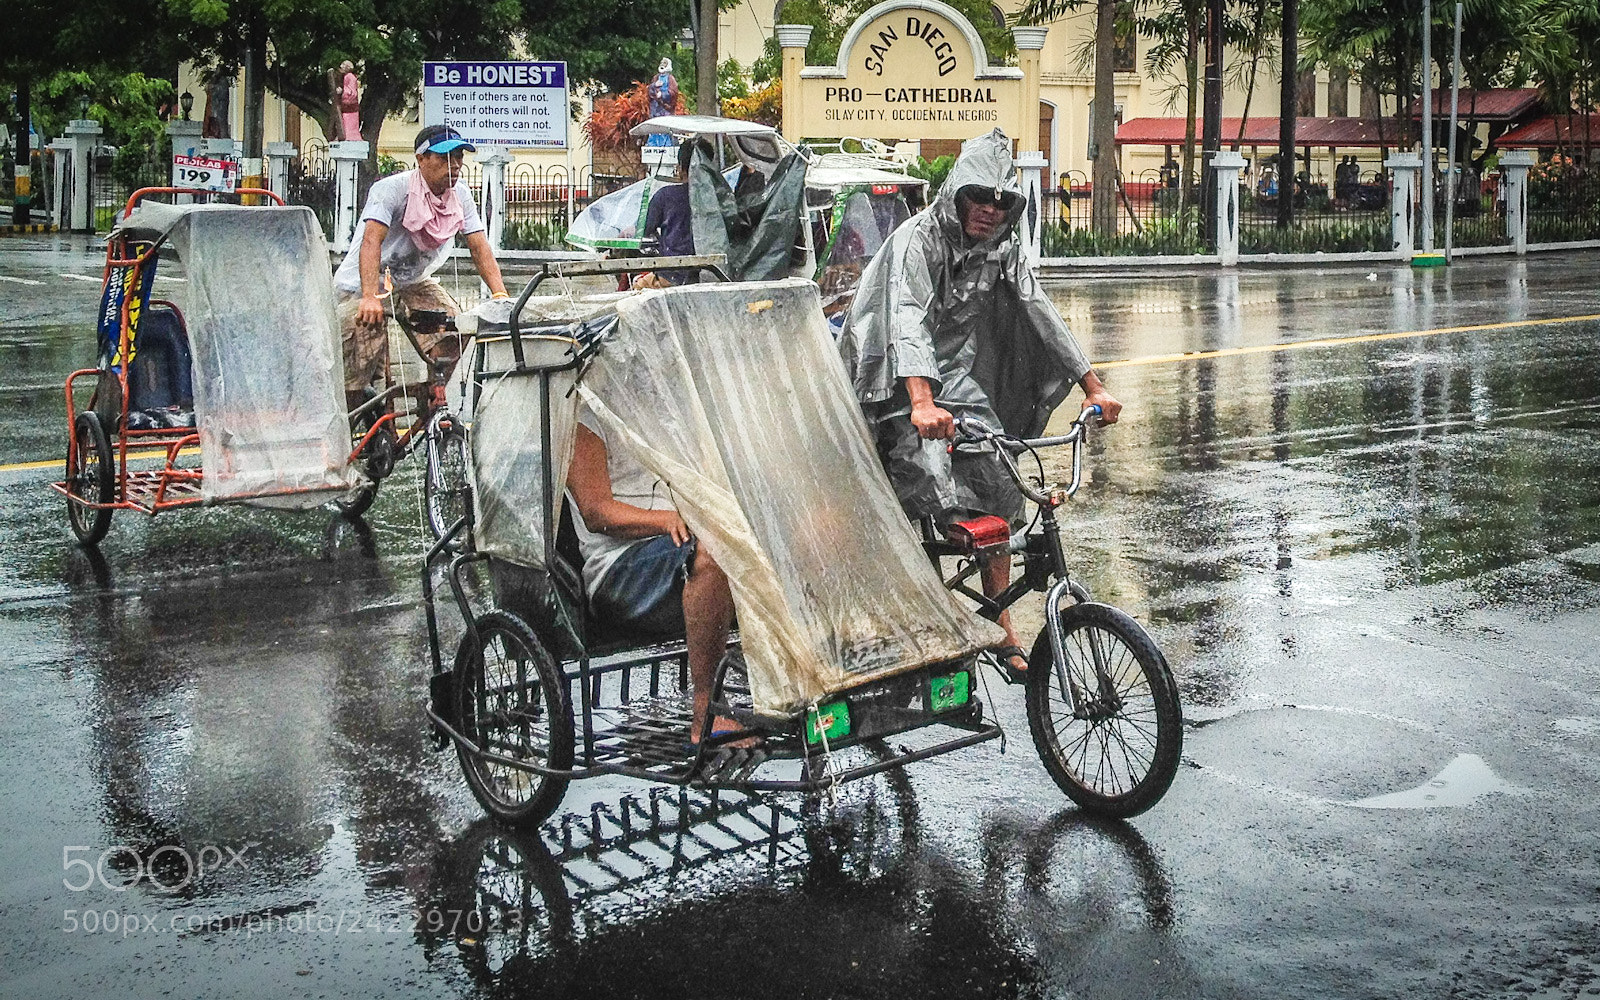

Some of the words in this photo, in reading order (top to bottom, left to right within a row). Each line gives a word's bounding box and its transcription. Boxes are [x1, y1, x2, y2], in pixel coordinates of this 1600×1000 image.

[865, 25, 899, 77] SAN
[906, 17, 957, 77] DIEGO
[434, 65, 461, 84] Be
[467, 65, 556, 85] HONEST
[443, 91, 467, 101] Even
[469, 91, 477, 101] if
[478, 91, 509, 101] others
[511, 93, 528, 102] are
[530, 92, 549, 102] not.
[443, 104, 467, 115] Even
[469, 104, 477, 115] if
[478, 104, 510, 115] others
[512, 105, 529, 116] will
[531, 106, 550, 116] not.
[825, 109, 855, 121] SILAY
[892, 109, 955, 121] OCCIDENTAL
[958, 109, 998, 121] NEGROS
[443, 117, 467, 128] Even
[469, 117, 477, 128] if
[478, 118, 510, 129] others
[512, 120, 530, 129] can
[532, 119, 551, 130] not.
[176, 156, 222, 169] PEDICAB
[179, 168, 211, 183] 199
